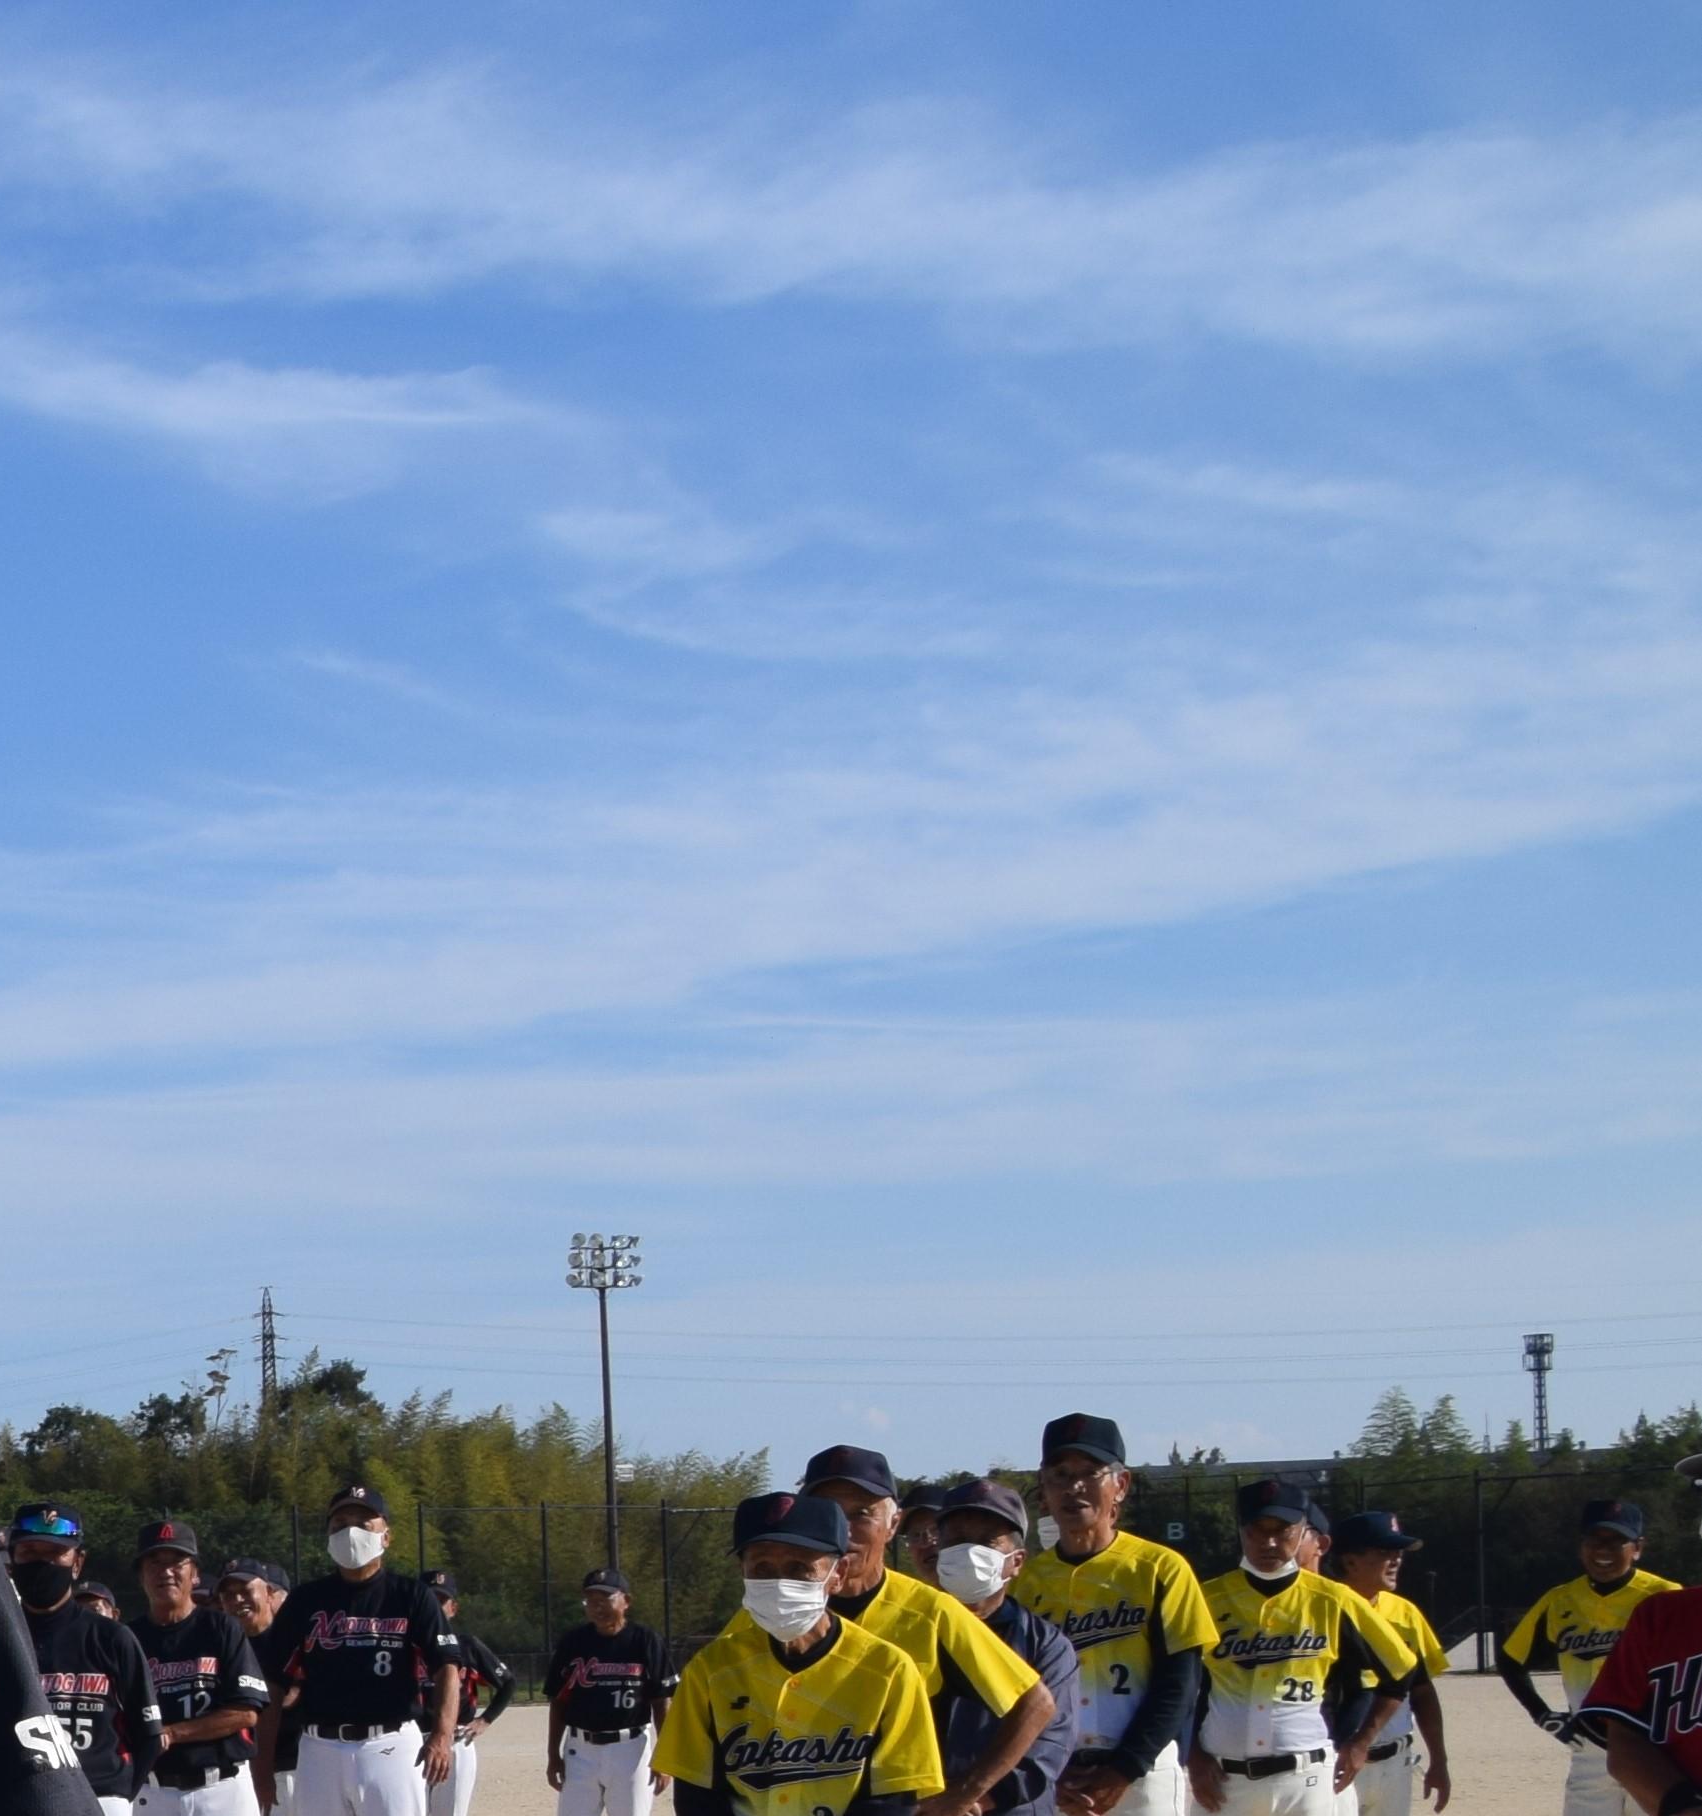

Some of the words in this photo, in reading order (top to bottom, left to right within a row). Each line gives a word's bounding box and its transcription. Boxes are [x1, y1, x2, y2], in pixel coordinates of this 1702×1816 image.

[1167, 1522, 1185, 1541] B
[1042, 1599, 1146, 1635] kasho
[1213, 1628, 1328, 1660] Gokasho
[373, 1650, 393, 1677] 8
[1110, 1663, 1132, 1696] 2
[1281, 1677, 1316, 1703] 28
[77, 1702, 105, 1712] CLUB
[177, 1690, 212, 1719] 12
[609, 1689, 636, 1709] 16
